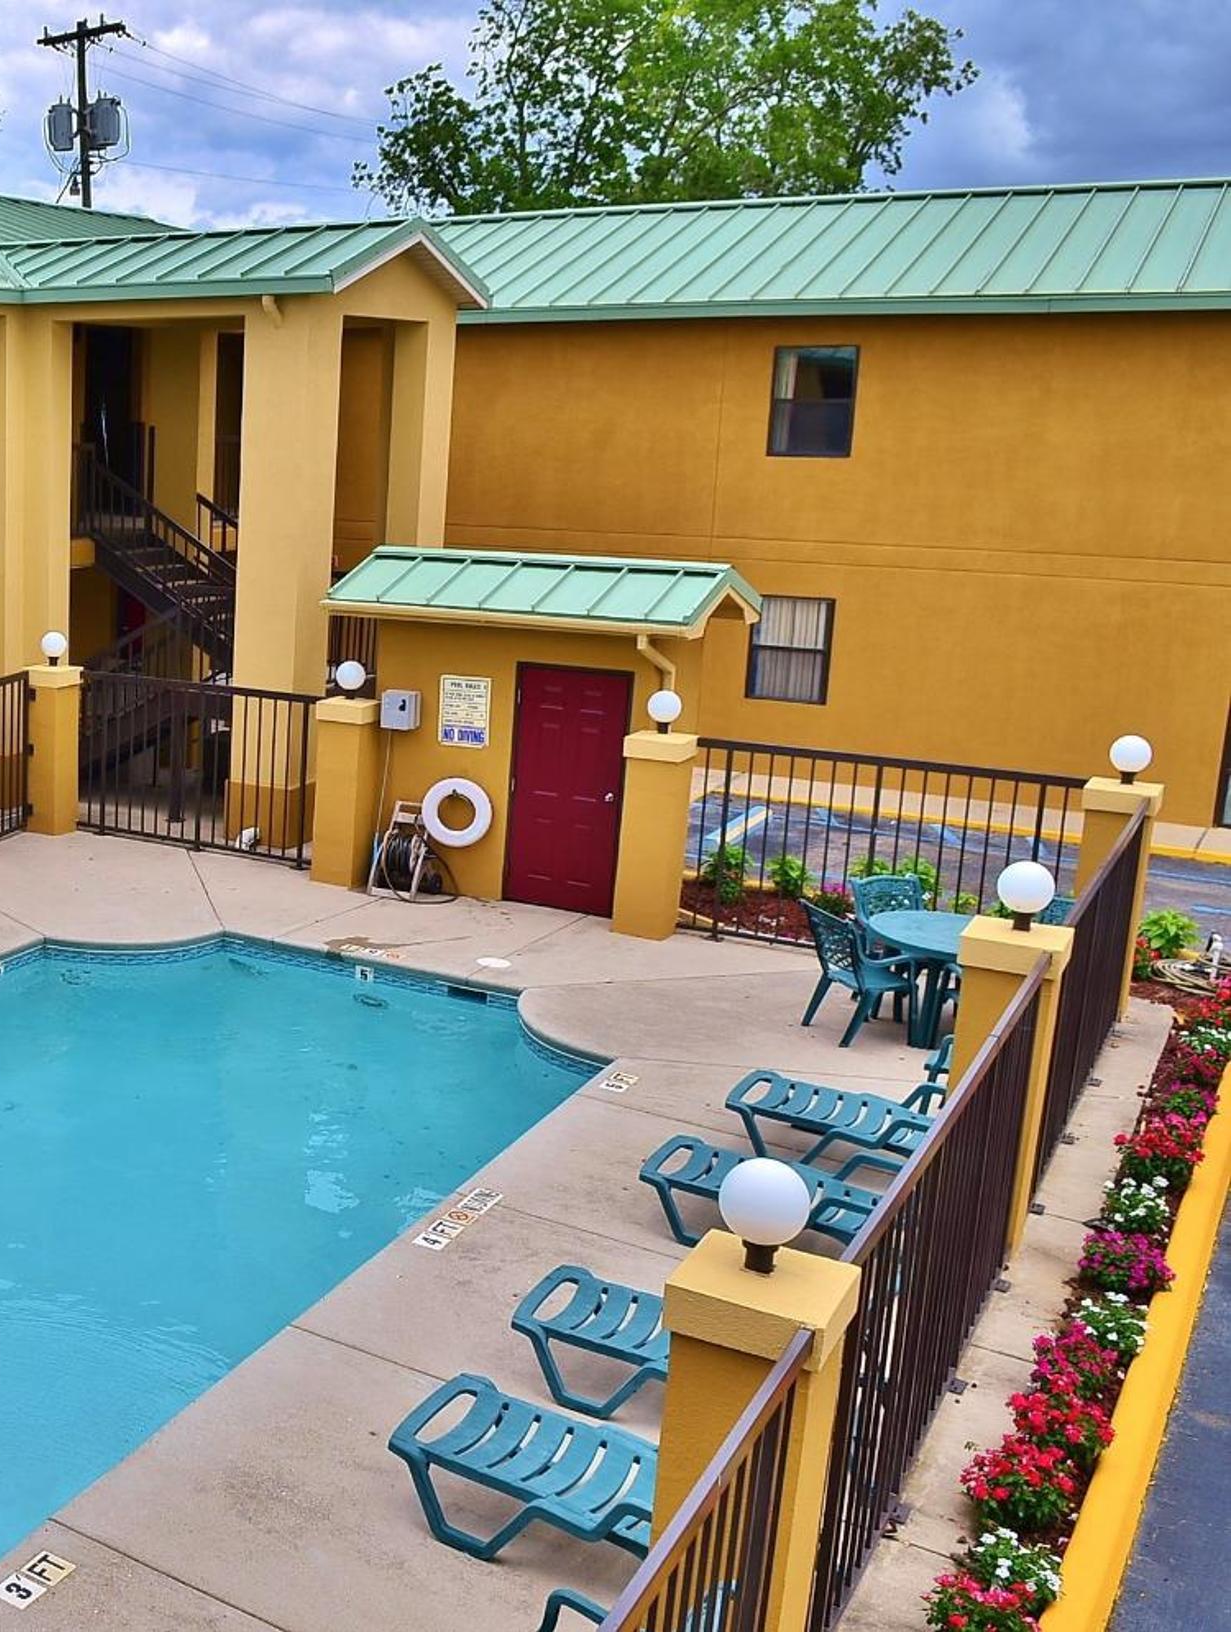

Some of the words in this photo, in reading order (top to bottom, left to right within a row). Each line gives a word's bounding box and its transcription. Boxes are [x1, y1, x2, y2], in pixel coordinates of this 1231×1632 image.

[443, 727, 455, 742] NO
[457, 727, 485, 743] DIVING
[360, 968, 369, 981] 5
[27, 1554, 66, 1582] FT
